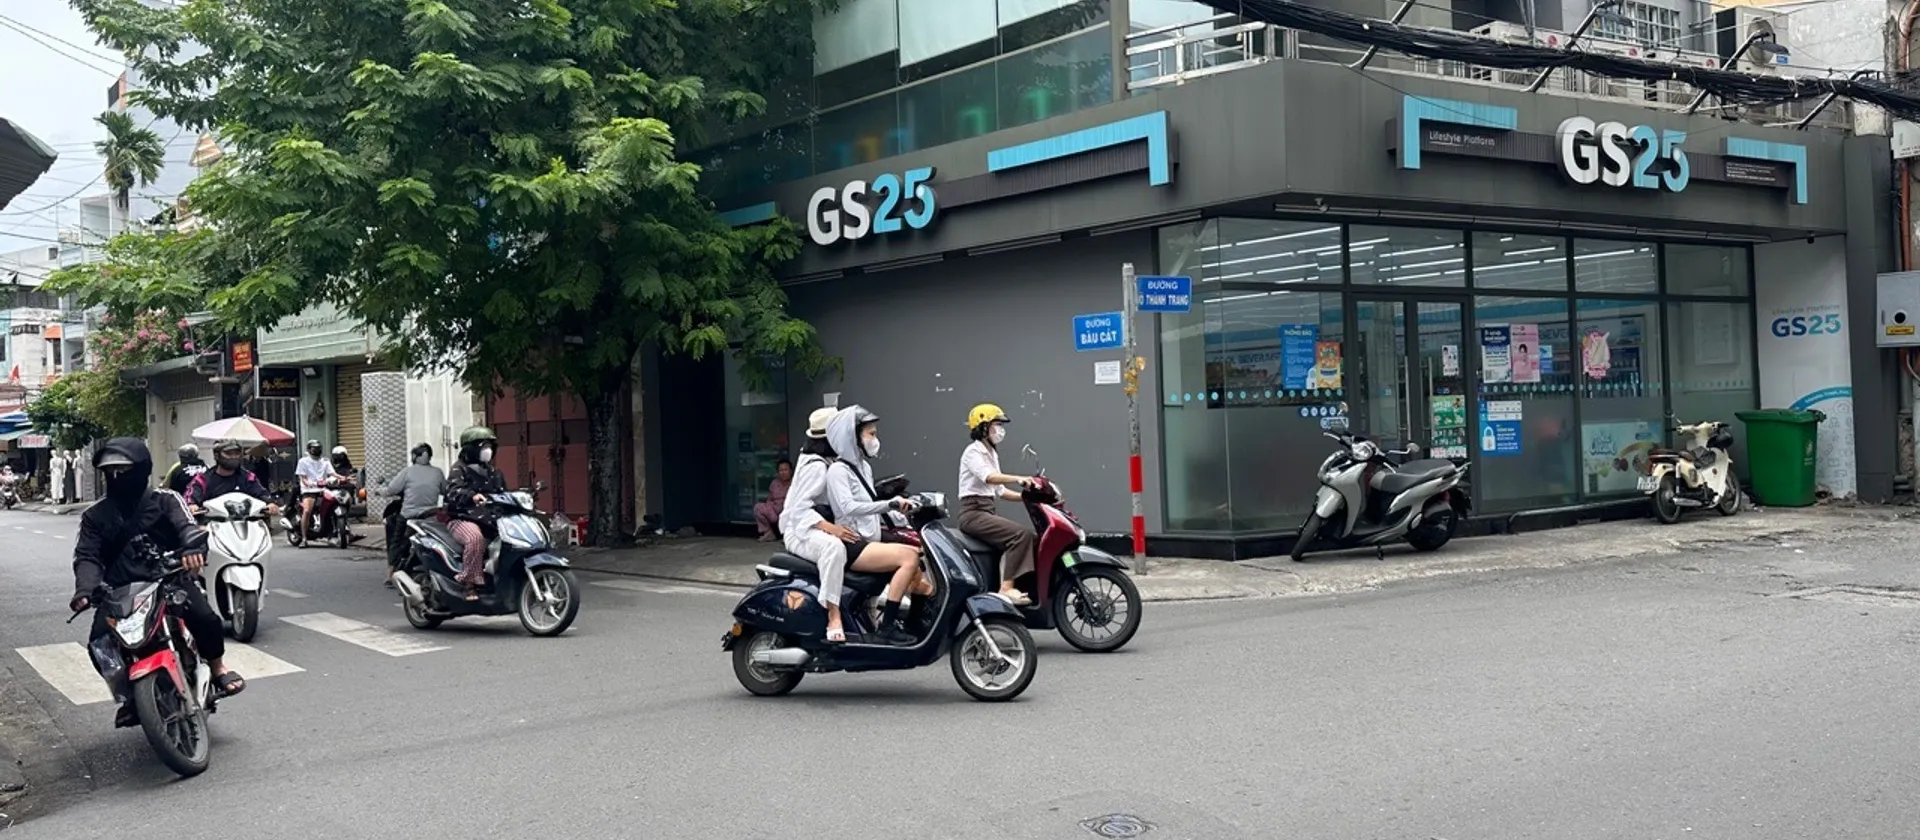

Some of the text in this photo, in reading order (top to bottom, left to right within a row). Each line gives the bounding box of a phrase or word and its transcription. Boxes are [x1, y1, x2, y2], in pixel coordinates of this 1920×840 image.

[1429, 130, 1495, 146] Lifestyle Platform
[1557, 116, 1690, 192] GS25
[807, 166, 936, 246] GS25
[1147, 278, 1178, 290] ĐƯỜNG
[1168, 294, 1189, 306] TRANG
[1085, 317, 1111, 329] ĐƯỜNG
[1771, 313, 1842, 338] GS25
[1100, 328, 1117, 343] CÁT
